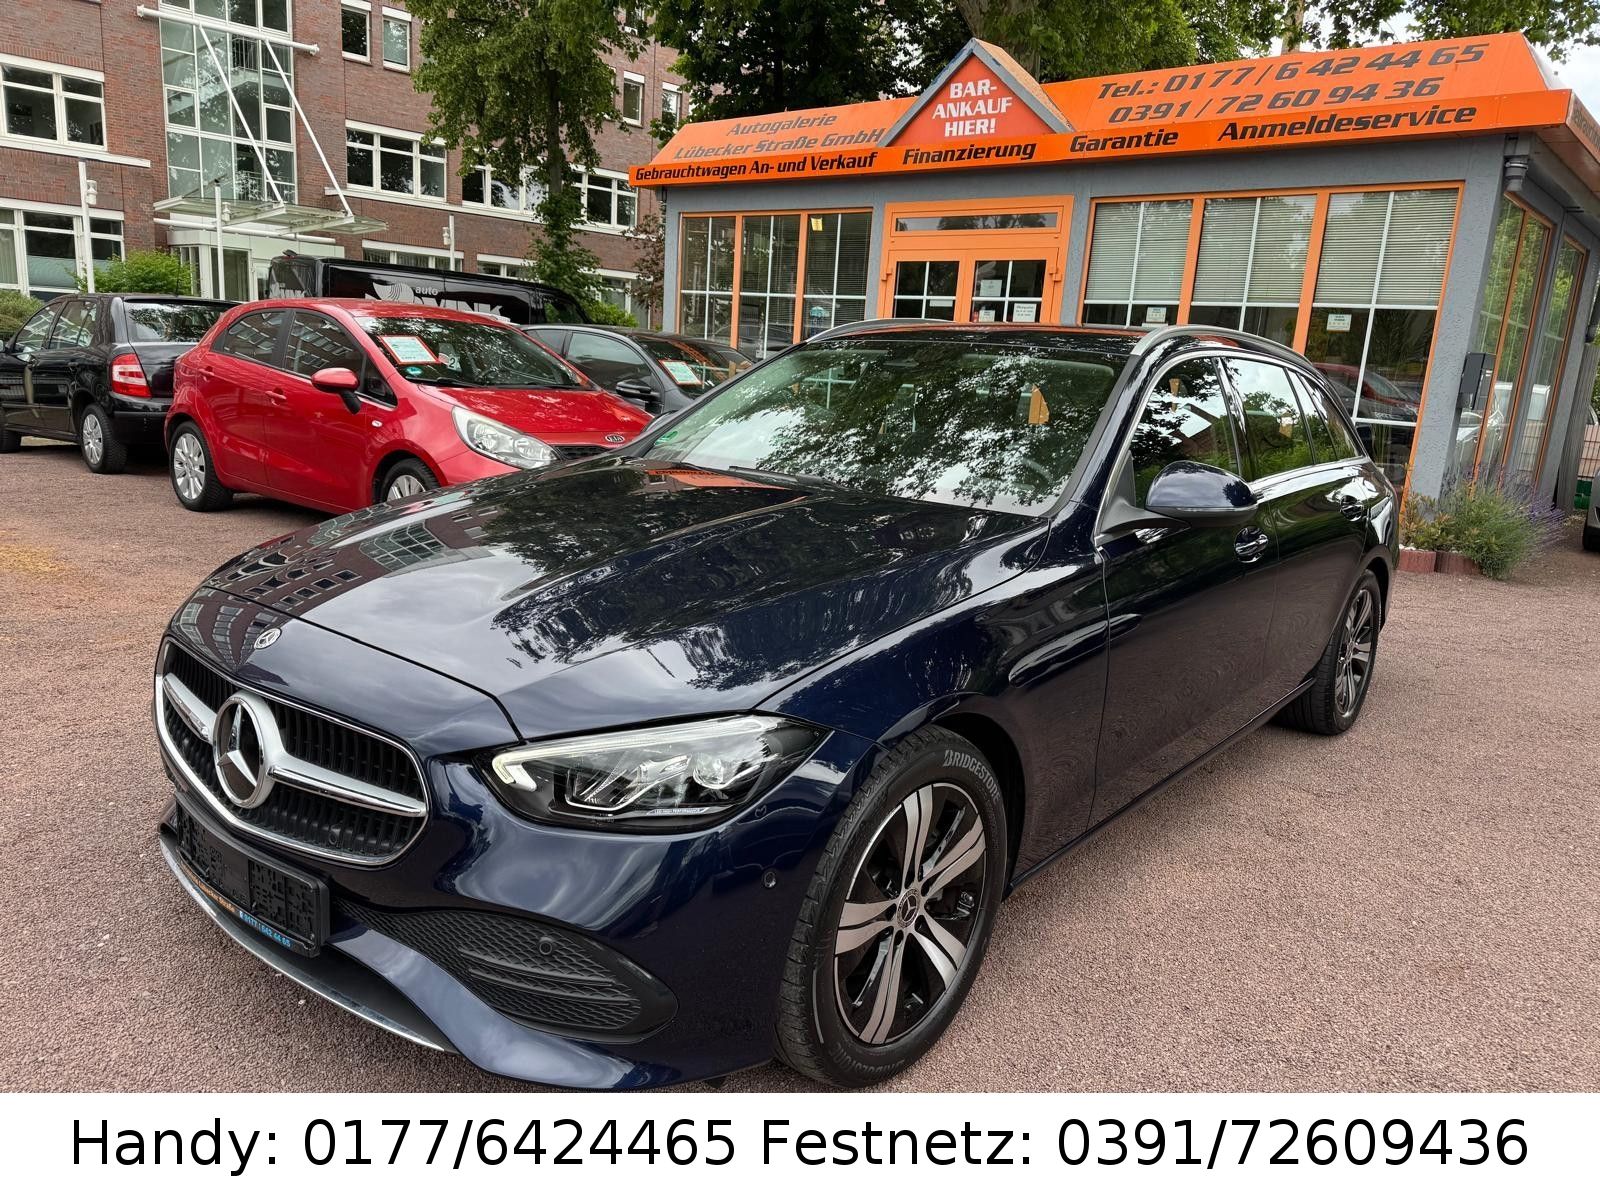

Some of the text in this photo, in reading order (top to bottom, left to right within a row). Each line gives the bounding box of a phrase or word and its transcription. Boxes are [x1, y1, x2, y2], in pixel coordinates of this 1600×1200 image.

[1098, 80, 1160, 100] Tel.:
[1163, 67, 1256, 93] 0177
[1428, 43, 1490, 66] 65
[950, 79, 998, 99] BAR-
[1108, 100, 1193, 123] 0391
[1384, 76, 1445, 100] 36
[932, 97, 1013, 119] ANKAUF
[727, 113, 837, 136] Autogalerie
[945, 118, 997, 137] HIER!
[1218, 105, 1477, 142] Anmeldeservice
[673, 128, 886, 160] Lübecker Straße GmbH
[1070, 128, 1179, 153] Garantie
[902, 143, 1037, 165] Finanzierung
[635, 152, 878, 181] Gebrauchtwagen An- und Verkauf
[415, 285, 439, 296] auto
